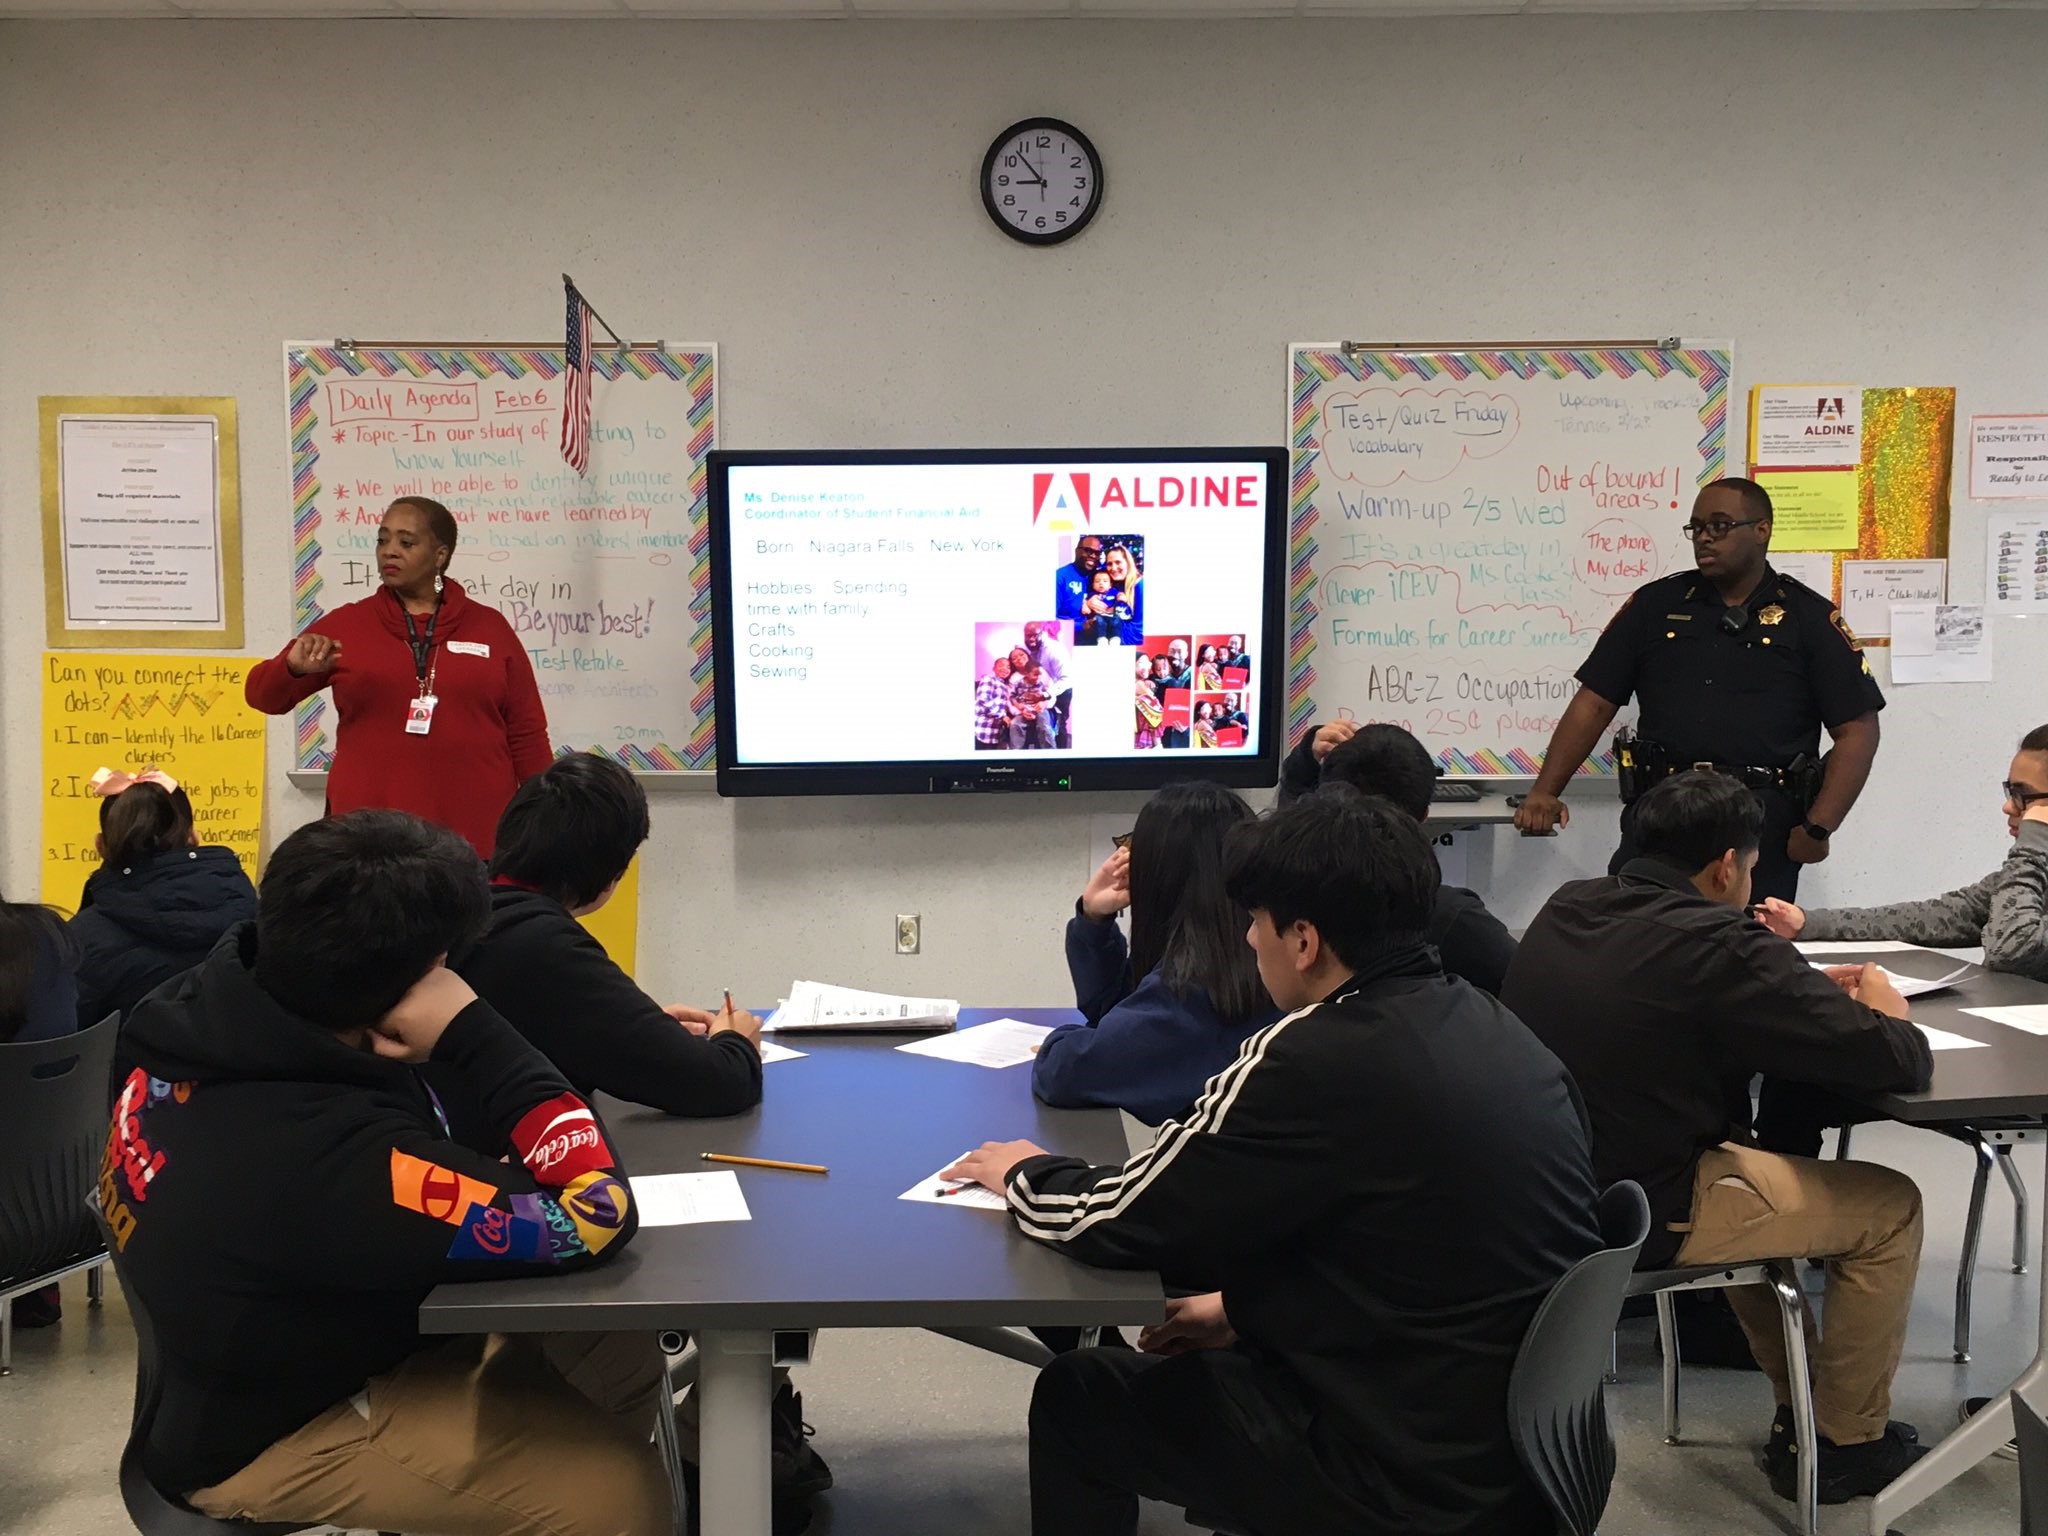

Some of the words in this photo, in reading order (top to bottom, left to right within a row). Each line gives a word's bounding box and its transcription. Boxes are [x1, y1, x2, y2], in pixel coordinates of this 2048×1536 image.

[1019, 141, 1029, 153] 11
[1036, 136, 1051, 149] 12
[1061, 142, 1065, 154] 1
[1004, 155, 1017, 168] 10
[1070, 156, 1082, 169] 2
[997, 174, 1010, 186] 9
[1073, 177, 1087, 189] 3
[1003, 194, 1016, 206] 8
[1069, 195, 1081, 207] 4
[1017, 209, 1028, 222] 7
[1034, 216, 1047, 228] 6
[1055, 210, 1067, 223] 5
[340, 387, 392, 417] Daily
[406, 387, 471, 414] Agenda
[1454, 401, 1509, 429] Friday
[446, 428, 475, 442] our
[480, 420, 524, 445] study
[531, 418, 549, 441] of
[644, 420, 666, 440] to
[1804, 425, 1855, 436] ALDINE
[355, 478, 383, 497] We
[393, 477, 423, 496] will
[431, 477, 452, 496] be
[458, 473, 496, 495] able
[503, 472, 519, 491] to
[1536, 464, 1574, 493] Out
[1579, 460, 1601, 497] of
[1988, 472, 2022, 486] Ready
[2024, 473, 2036, 483] to
[770, 492, 814, 503] Denise
[819, 492, 866, 503] Keaton
[1100, 475, 1258, 508] ALDINE
[1337, 488, 1451, 528] Warm-up
[1462, 487, 1502, 527] 2/5
[1512, 495, 1567, 526] Wed
[1596, 492, 1659, 510] areas
[487, 508, 509, 523] we
[515, 504, 551, 522] have
[563, 504, 627, 523] learned
[631, 504, 652, 529] by
[744, 508, 822, 520] Coordinator
[827, 508, 839, 519] of
[843, 508, 893, 519] Student
[896, 507, 955, 519] Financial
[959, 507, 981, 518] Aid
[810, 540, 872, 557] Niagara
[930, 539, 965, 552] New
[972, 538, 1005, 552] York
[1340, 532, 1399, 562] It's
[1407, 543, 1424, 560] a
[1586, 532, 1612, 552] The
[1617, 534, 1652, 557] phone
[1586, 558, 1610, 581] My
[1612, 557, 1649, 577] desk
[500, 575, 540, 608] day
[551, 573, 572, 600] in
[833, 580, 908, 597] Spending
[747, 603, 781, 616] time
[786, 603, 817, 616] with
[823, 601, 869, 618] family
[507, 599, 546, 633] Be
[547, 610, 596, 648] your
[597, 596, 655, 639] best!
[748, 622, 796, 637] Crafts
[1331, 617, 1421, 647] Formulas
[1427, 618, 1451, 646] for
[1457, 618, 1517, 647] Career
[528, 648, 570, 671] Test
[572, 647, 626, 672] Retake
[749, 643, 814, 660] Cooking
[50, 657, 87, 684] Can
[94, 665, 128, 690] you
[134, 663, 206, 685] connect
[210, 665, 242, 684] the
[749, 664, 807, 681] Sewing
[64, 689, 111, 713] dots?
[65, 725, 80, 745] I
[84, 730, 109, 745] can
[180, 727, 206, 745] the
[211, 725, 225, 742] 16
[226, 723, 265, 741] Career
[613, 725, 636, 741] 20
[124, 748, 176, 764] clusters
[67, 775, 81, 798] I
[206, 777, 240, 806] jobs
[243, 780, 258, 798] to
[193, 806, 243, 822] career
[62, 842, 76, 861] I
